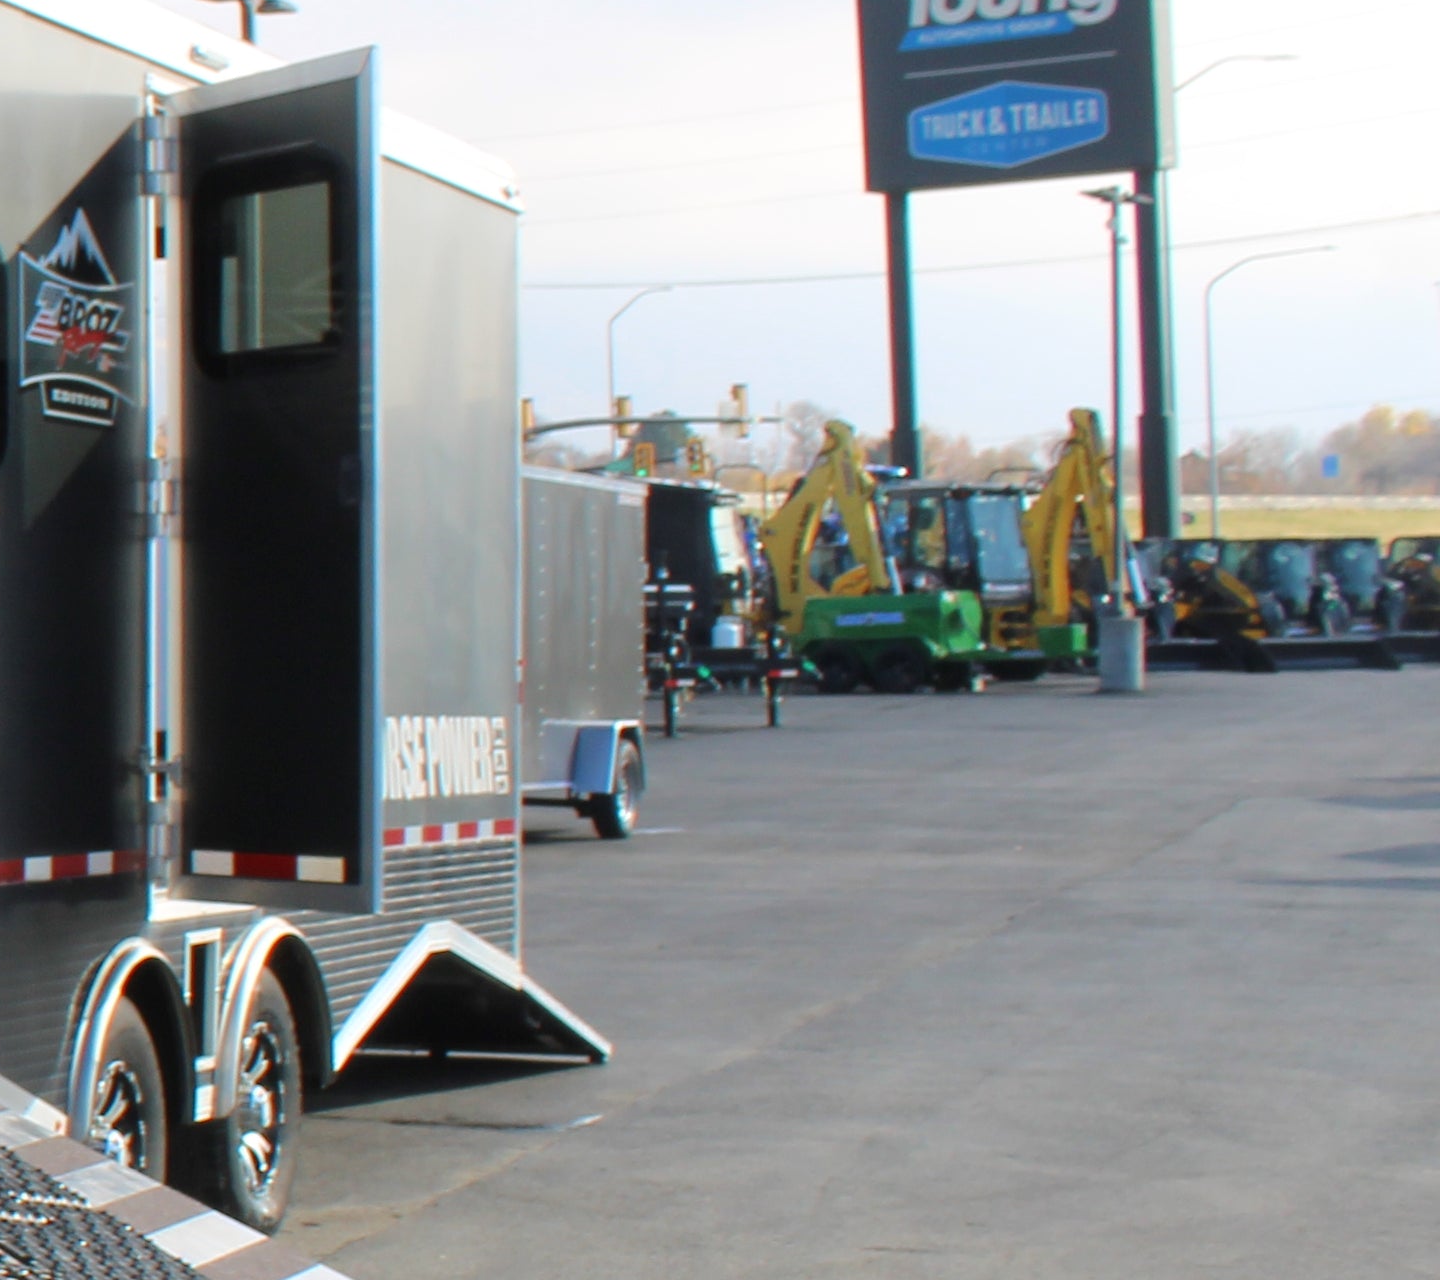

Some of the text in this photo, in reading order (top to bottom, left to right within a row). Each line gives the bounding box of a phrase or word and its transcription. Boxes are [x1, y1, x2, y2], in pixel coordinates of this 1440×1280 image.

[921, 98, 1099, 139] TRUCK & TRAILER
[51, 388, 109, 410] EDITION
